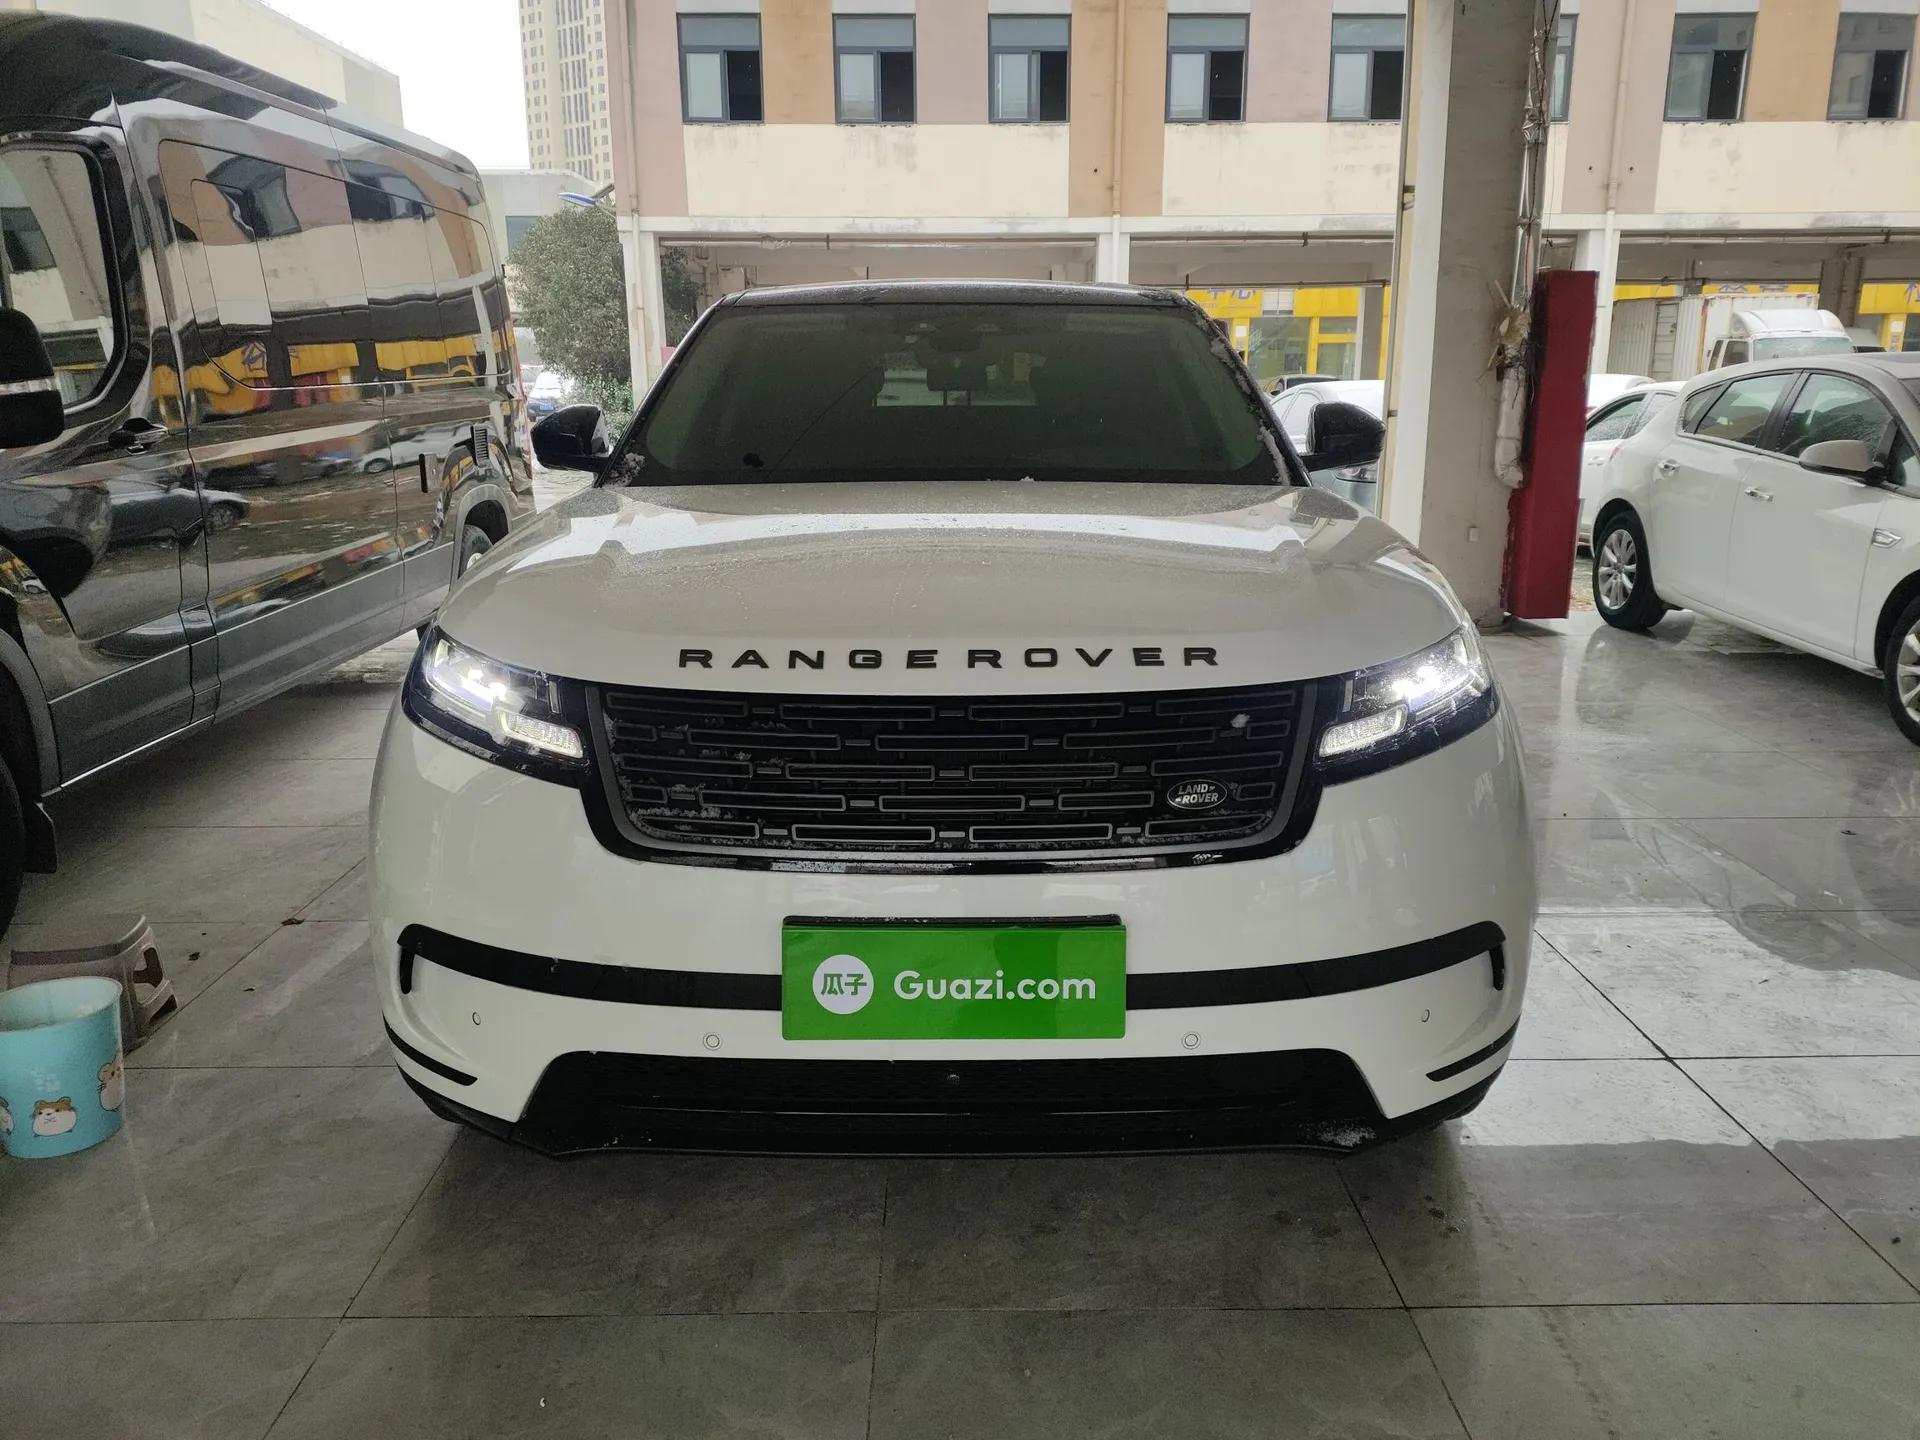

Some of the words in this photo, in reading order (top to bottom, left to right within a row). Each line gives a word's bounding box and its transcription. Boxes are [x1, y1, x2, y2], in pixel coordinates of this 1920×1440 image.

[678, 648, 939, 670] RANGE
[967, 647, 1219, 669] ROVER
[1178, 783, 1209, 795] LAND
[1182, 792, 1219, 804] ROVER
[820, 973, 867, 996] 瓜子
[893, 970, 1096, 1000] Guazi.com
